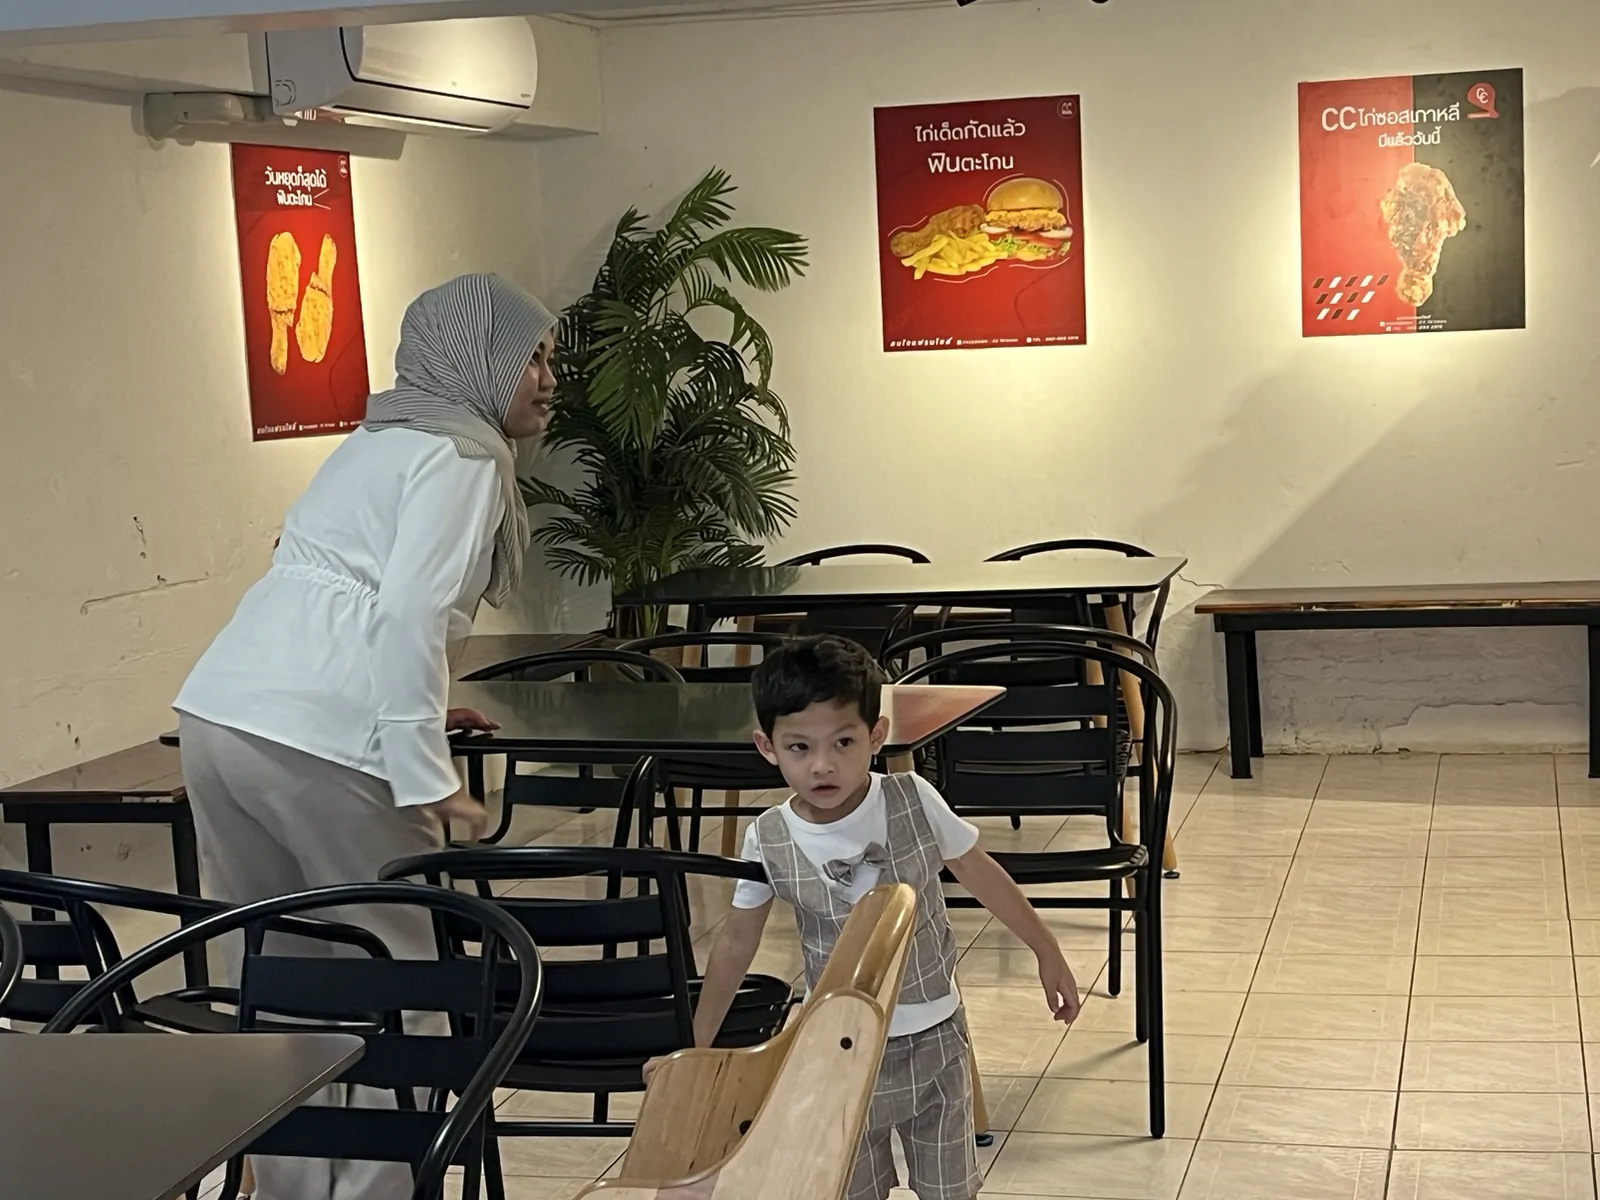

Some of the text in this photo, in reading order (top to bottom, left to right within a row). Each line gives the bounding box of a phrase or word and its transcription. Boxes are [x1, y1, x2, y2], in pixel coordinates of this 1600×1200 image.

[1321, 102, 1460, 131] CC ไก่ซอสเกาหลี
[914, 118, 1027, 142] ไก่เด็ดกัดแล้ว
[1378, 126, 1442, 148] มีแล้ววันนี้
[927, 152, 1015, 174] ฟินตะโกน
[264, 165, 327, 192] วันหยุดก็สุดได้
